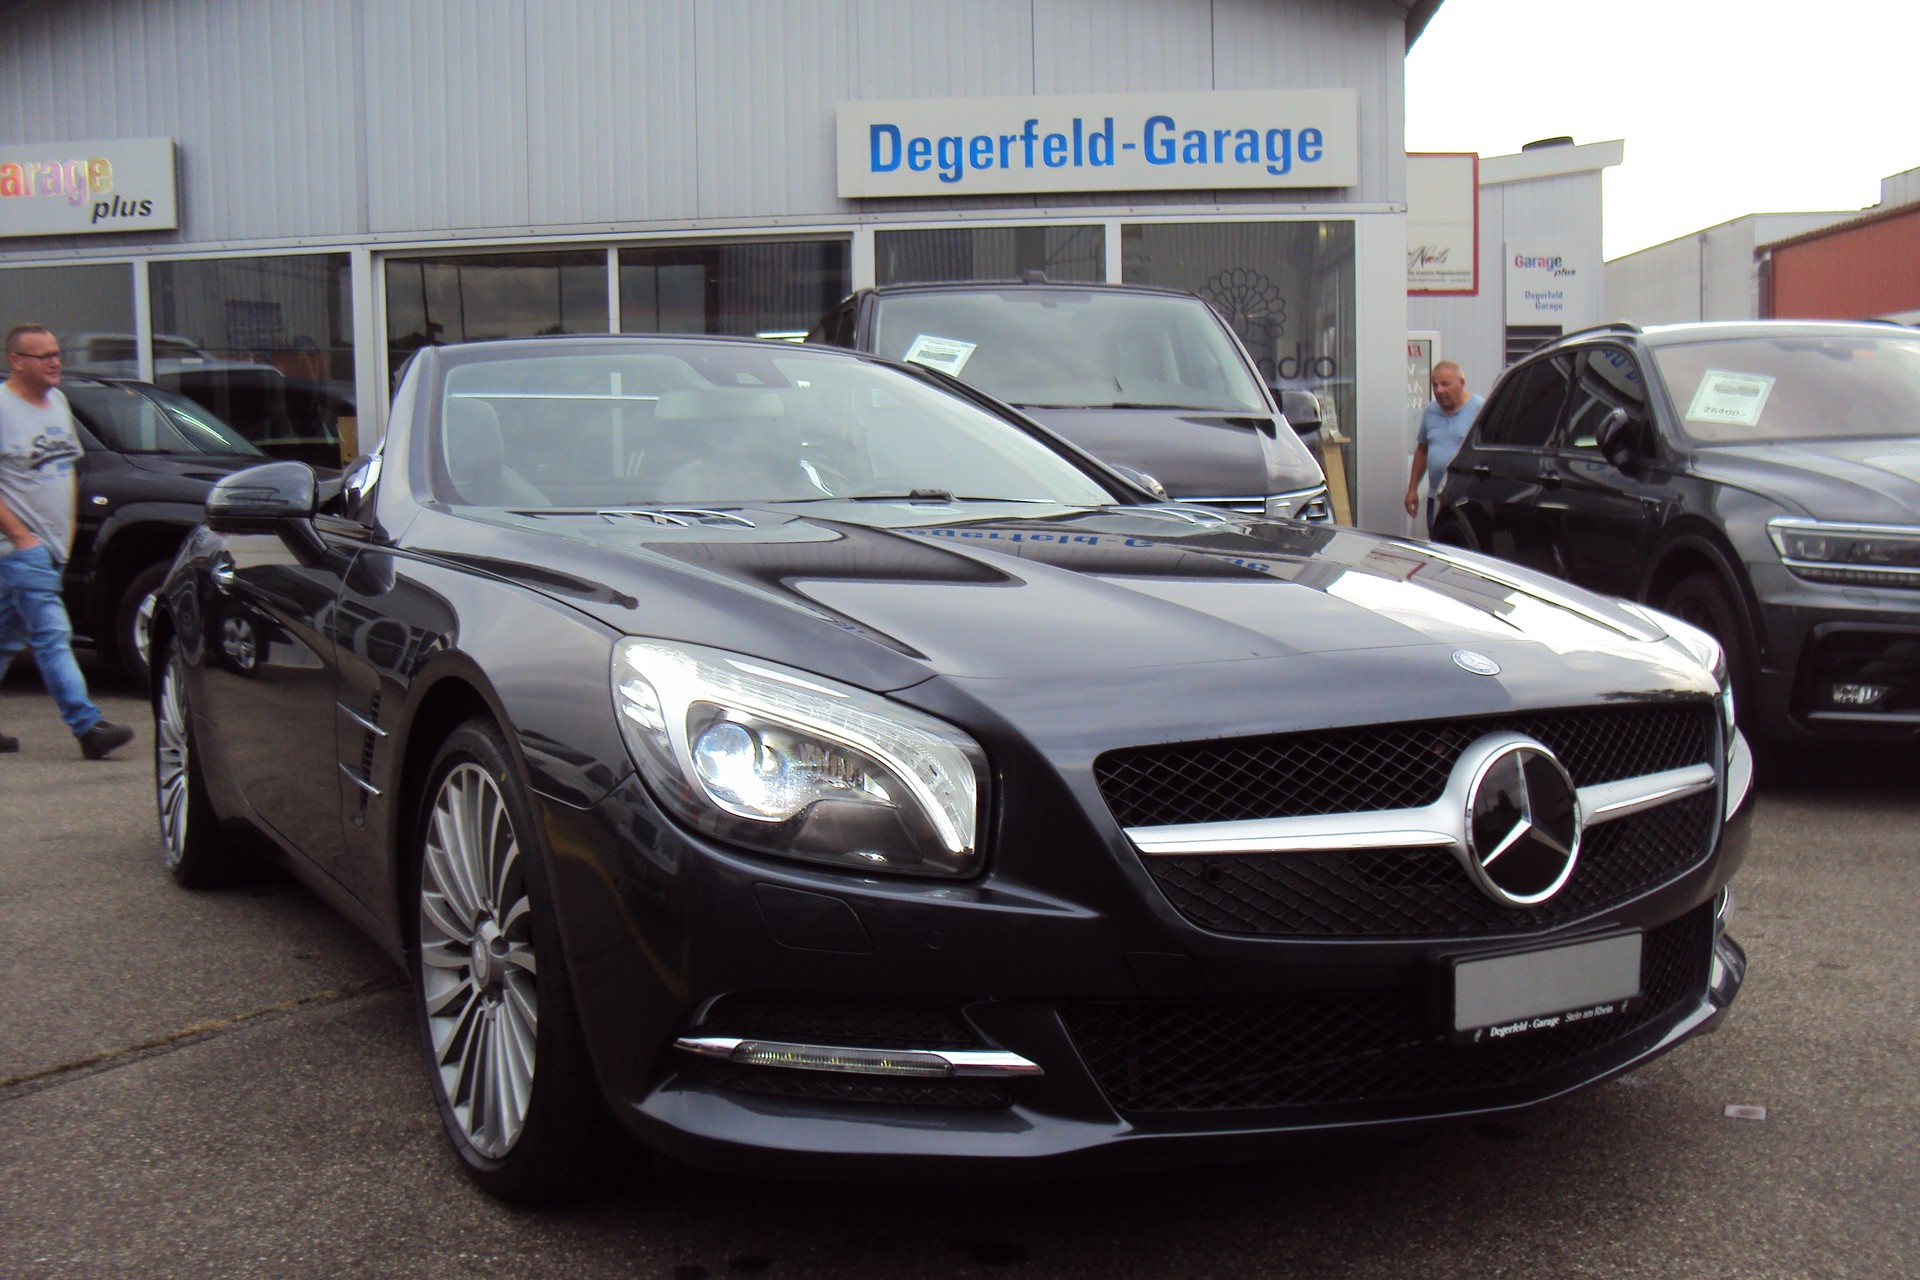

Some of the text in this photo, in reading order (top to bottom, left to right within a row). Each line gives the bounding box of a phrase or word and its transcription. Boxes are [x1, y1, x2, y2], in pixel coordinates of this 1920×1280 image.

[869, 115, 1323, 183] Degerfeld-Garage
[92, 195, 153, 224] plus
[1514, 255, 1562, 271] Garage
[1554, 268, 1577, 278] plus
[1525, 291, 1563, 301] Degerfeld
[1535, 302, 1563, 311] Garage
[1490, 1020, 1528, 1038] Degerfeld
[1532, 1016, 1560, 1030] Garage
[1594, 1004, 1614, 1017] Rhein
